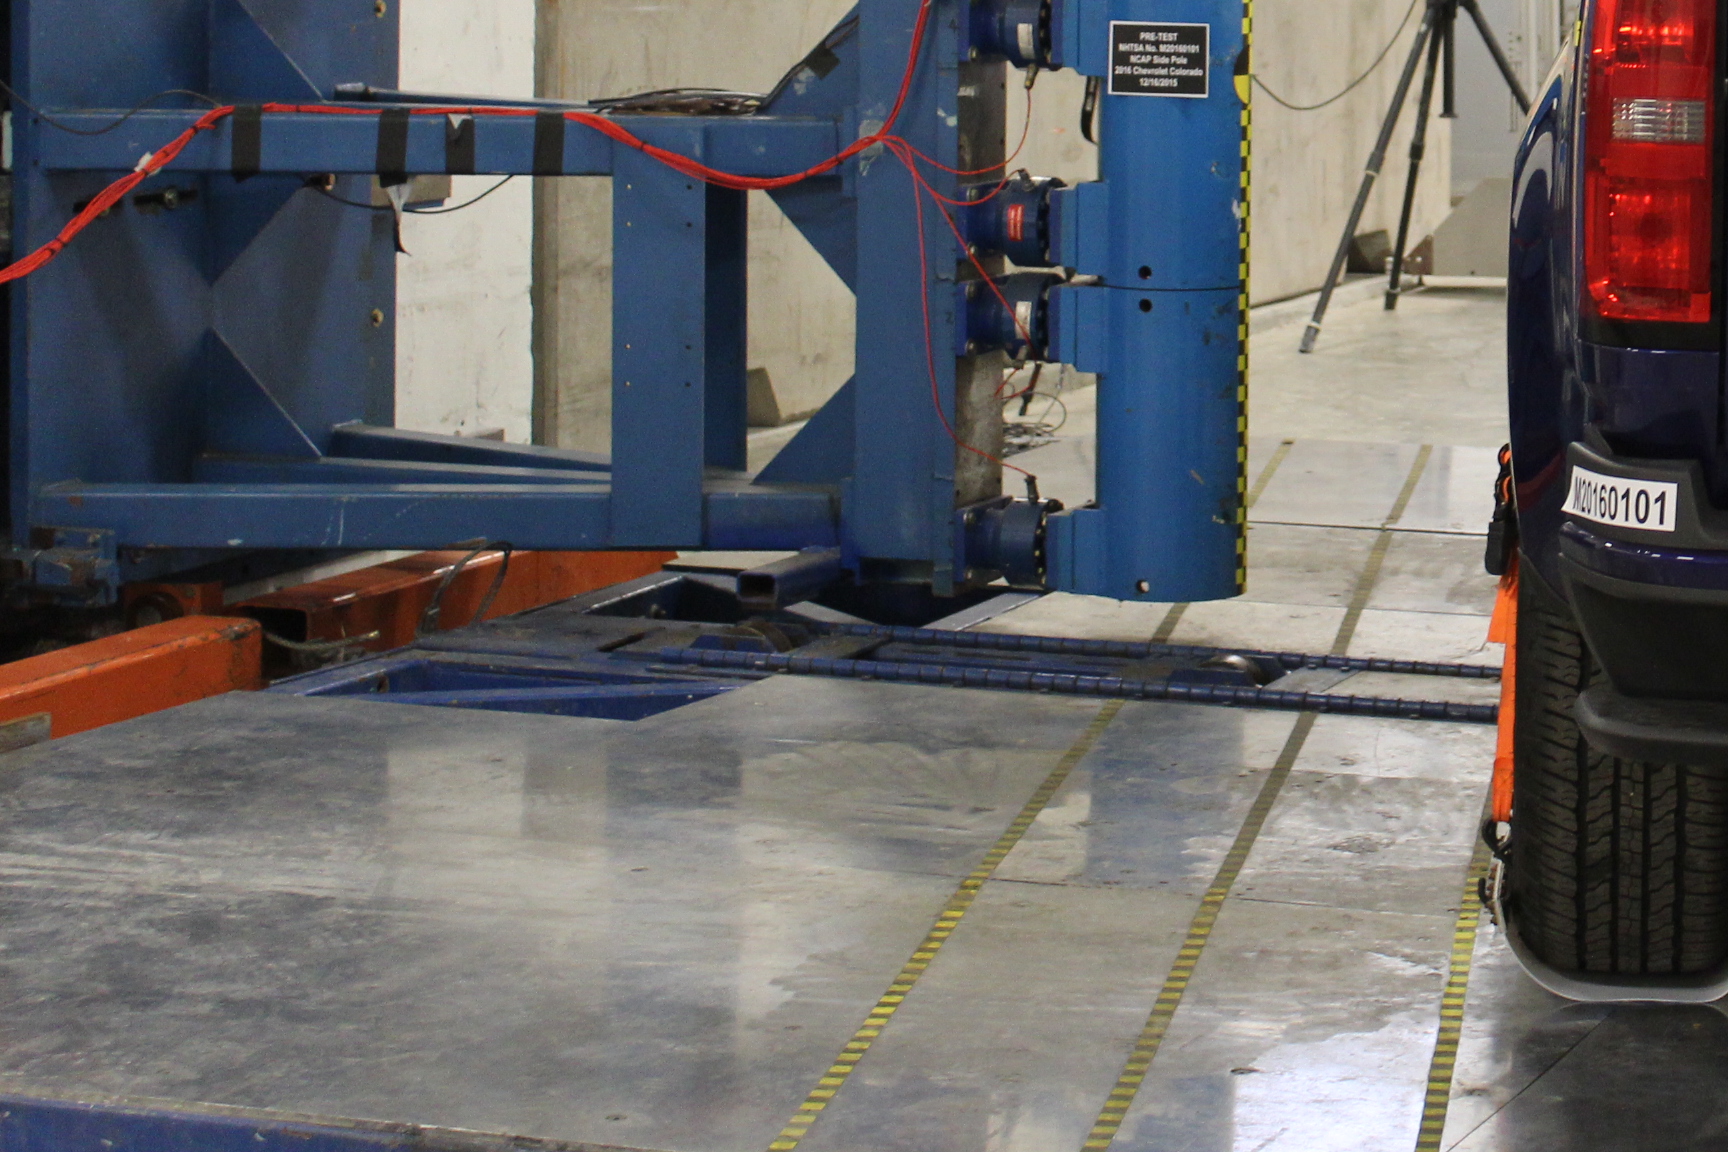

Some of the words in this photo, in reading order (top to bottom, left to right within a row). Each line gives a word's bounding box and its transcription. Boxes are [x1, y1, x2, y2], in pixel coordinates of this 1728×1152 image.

[1139, 31, 1178, 41] PRE-TEST
[1118, 42, 1144, 52] NHTSA
[1145, 43, 1157, 52] No.
[1159, 43, 1199, 53] M20160101
[1130, 54, 1151, 63] NCAP
[1153, 54, 1169, 64] Side
[1171, 55, 1188, 64] Pole
[1115, 65, 1131, 74] 2016
[1133, 65, 1168, 75] Chevrolet
[1170, 66, 1203, 76] Colorado
[1140, 77, 1178, 87] 12/16/2015
[1572, 476, 1667, 526] M20160101
